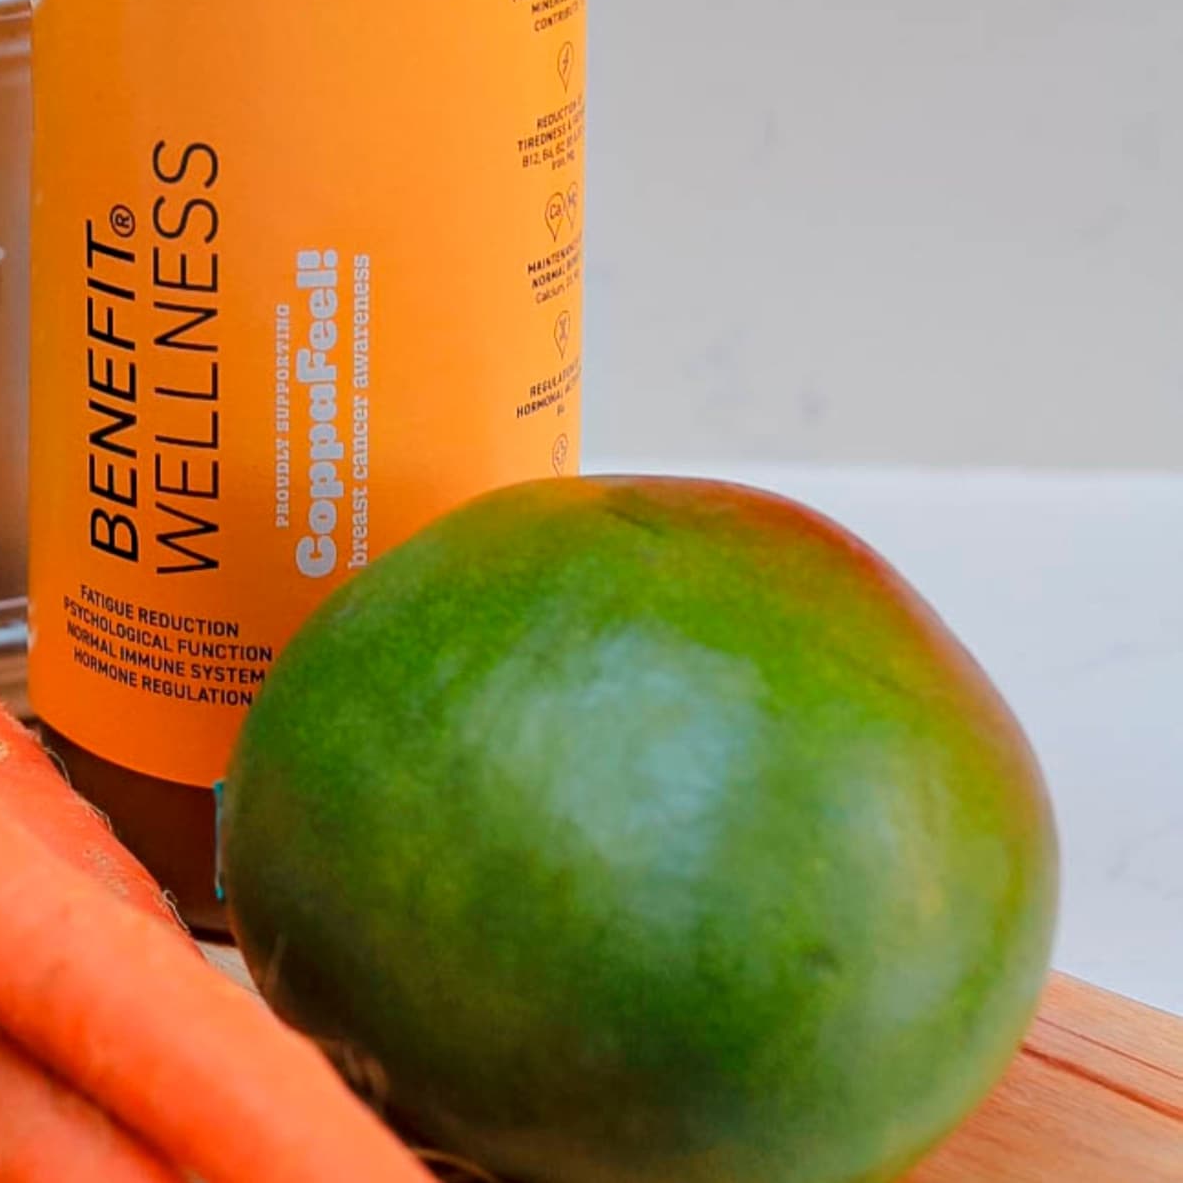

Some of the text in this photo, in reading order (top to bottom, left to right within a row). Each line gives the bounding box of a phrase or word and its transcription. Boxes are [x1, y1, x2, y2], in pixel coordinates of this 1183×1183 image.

[517, 122, 566, 152] TIREDNESS
[152, 139, 220, 575] WELLNESS
[275, 303, 290, 528] PROUDLY SUPPORTING
[295, 248, 345, 579] CoppaFeel!
[348, 253, 370, 569] breast cancer awareness
[63, 595, 273, 662] PSYCHOLOGICAL FUNCTION
[80, 584, 239, 638] FATIGUE REDUCTION
[67, 620, 265, 684] NORMAL IMMUNE SYSTEM
[74, 648, 253, 707] HORMONE REGULATION
